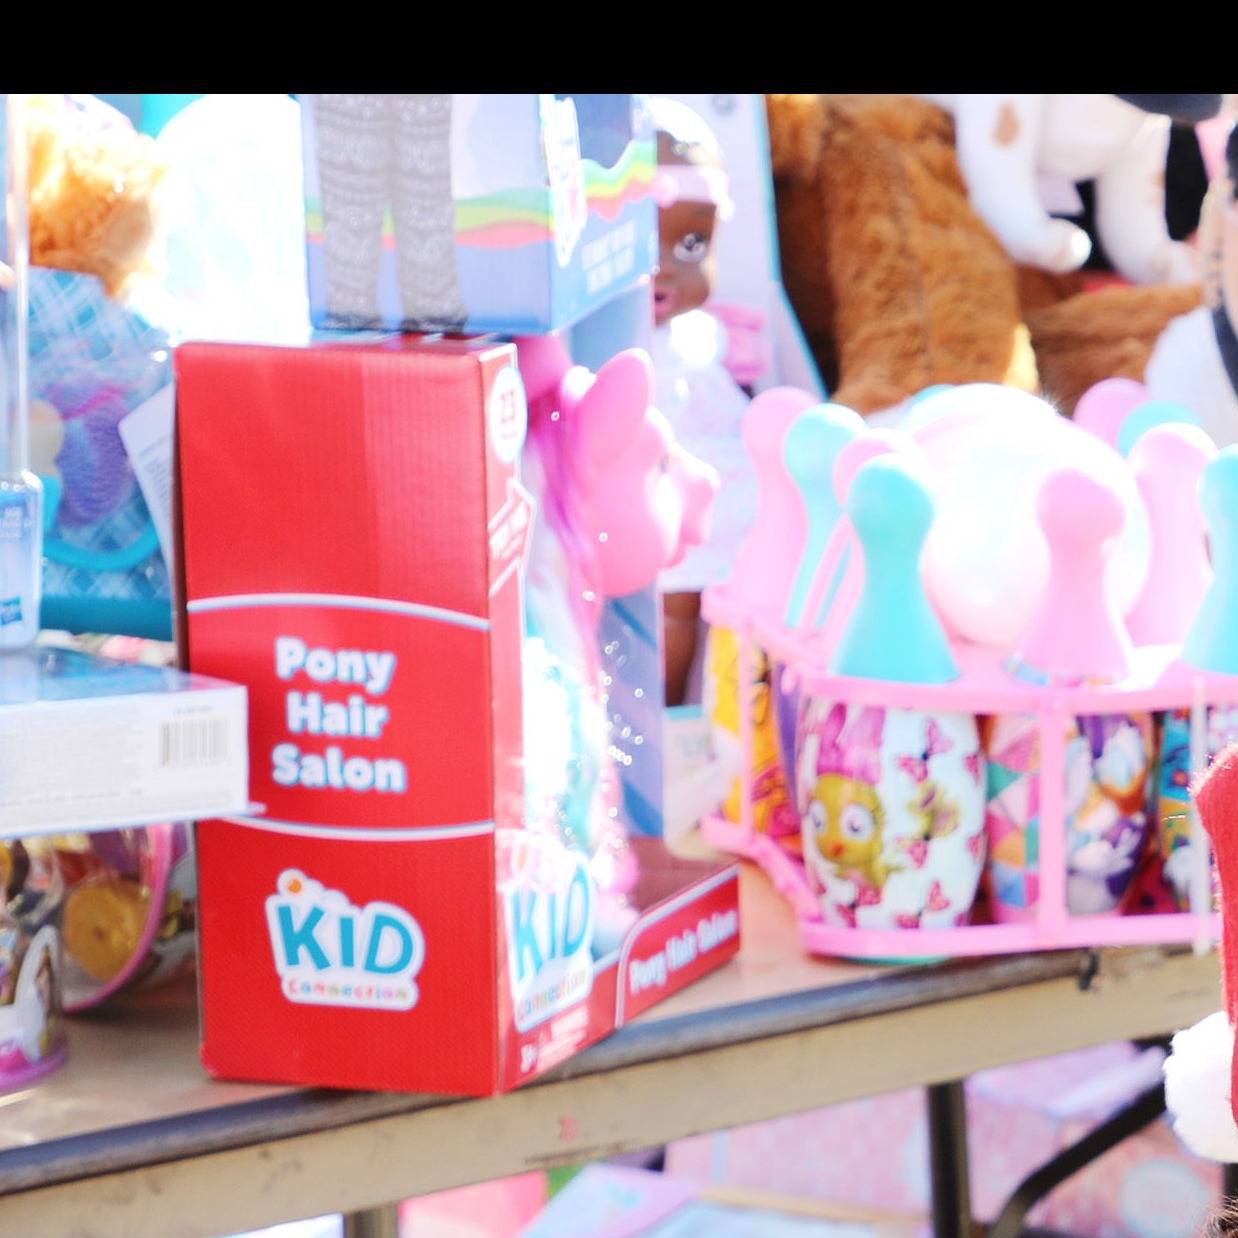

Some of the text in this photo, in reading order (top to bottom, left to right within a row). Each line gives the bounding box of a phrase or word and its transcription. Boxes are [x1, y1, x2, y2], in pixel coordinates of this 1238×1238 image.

[274, 634, 398, 695] Pony
[286, 689, 390, 740] Hair
[271, 741, 408, 794] Salon
[278, 905, 413, 975] KID
[511, 864, 591, 983] KID
[288, 980, 408, 1000] Connection
